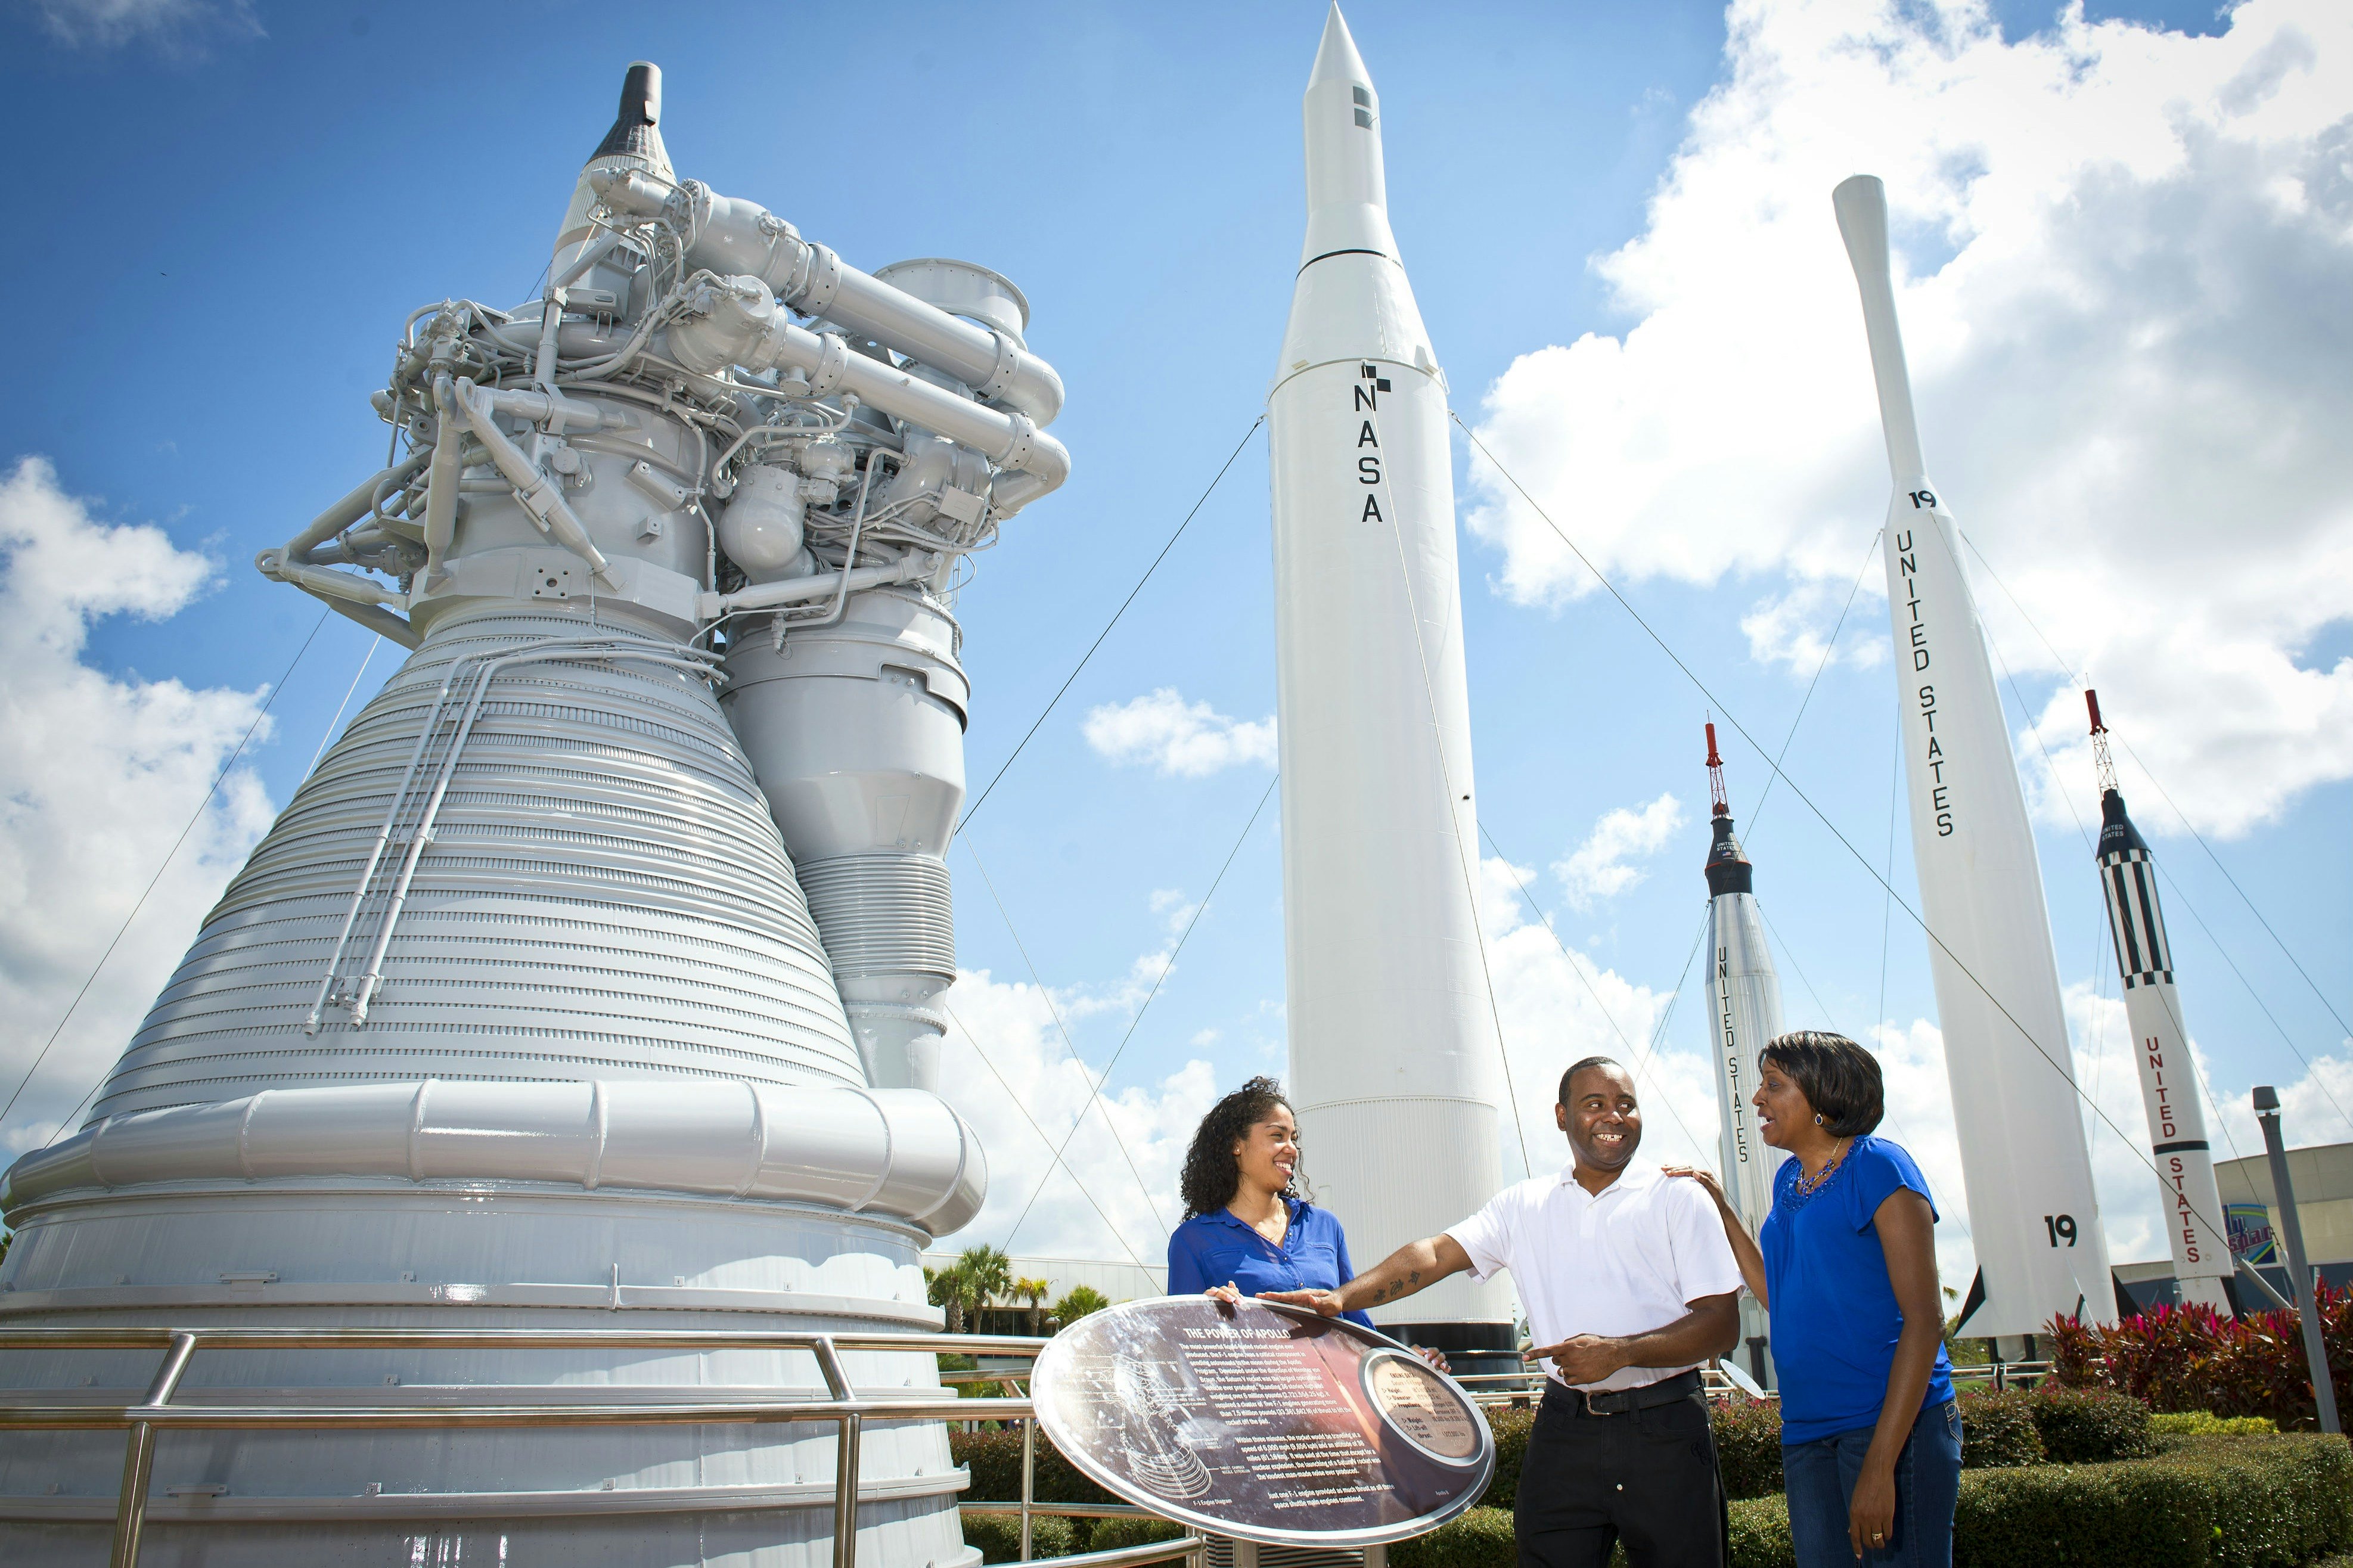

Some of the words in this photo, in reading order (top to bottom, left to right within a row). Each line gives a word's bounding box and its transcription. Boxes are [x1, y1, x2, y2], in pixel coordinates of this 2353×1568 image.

[1354, 385, 1383, 522] NASA
[1908, 490, 1936, 508] 19
[1897, 530, 1929, 672] UNITED
[1919, 685, 1953, 837] STATES
[2102, 824, 2124, 834] UNITED
[2101, 831, 2124, 841] STATES
[1718, 947, 1735, 1047] UNITED
[1729, 1057, 1747, 1163] STATES
[2146, 1036, 2175, 1138] UNITED
[2169, 1157, 2200, 1263] STATES
[2044, 1215, 2077, 1247] 19
[1183, 1328, 1206, 1338] THE
[1204, 1328, 1241, 1339] POWER
[1240, 1328, 1254, 1339] OF
[1255, 1328, 1292, 1339] APOLLO
[1271, 1462, 1297, 1470] explosion,
[1335, 1467, 1359, 1476] produced.
[1298, 1489, 1315, 1498] engine
[1320, 1497, 1339, 1505] engines
